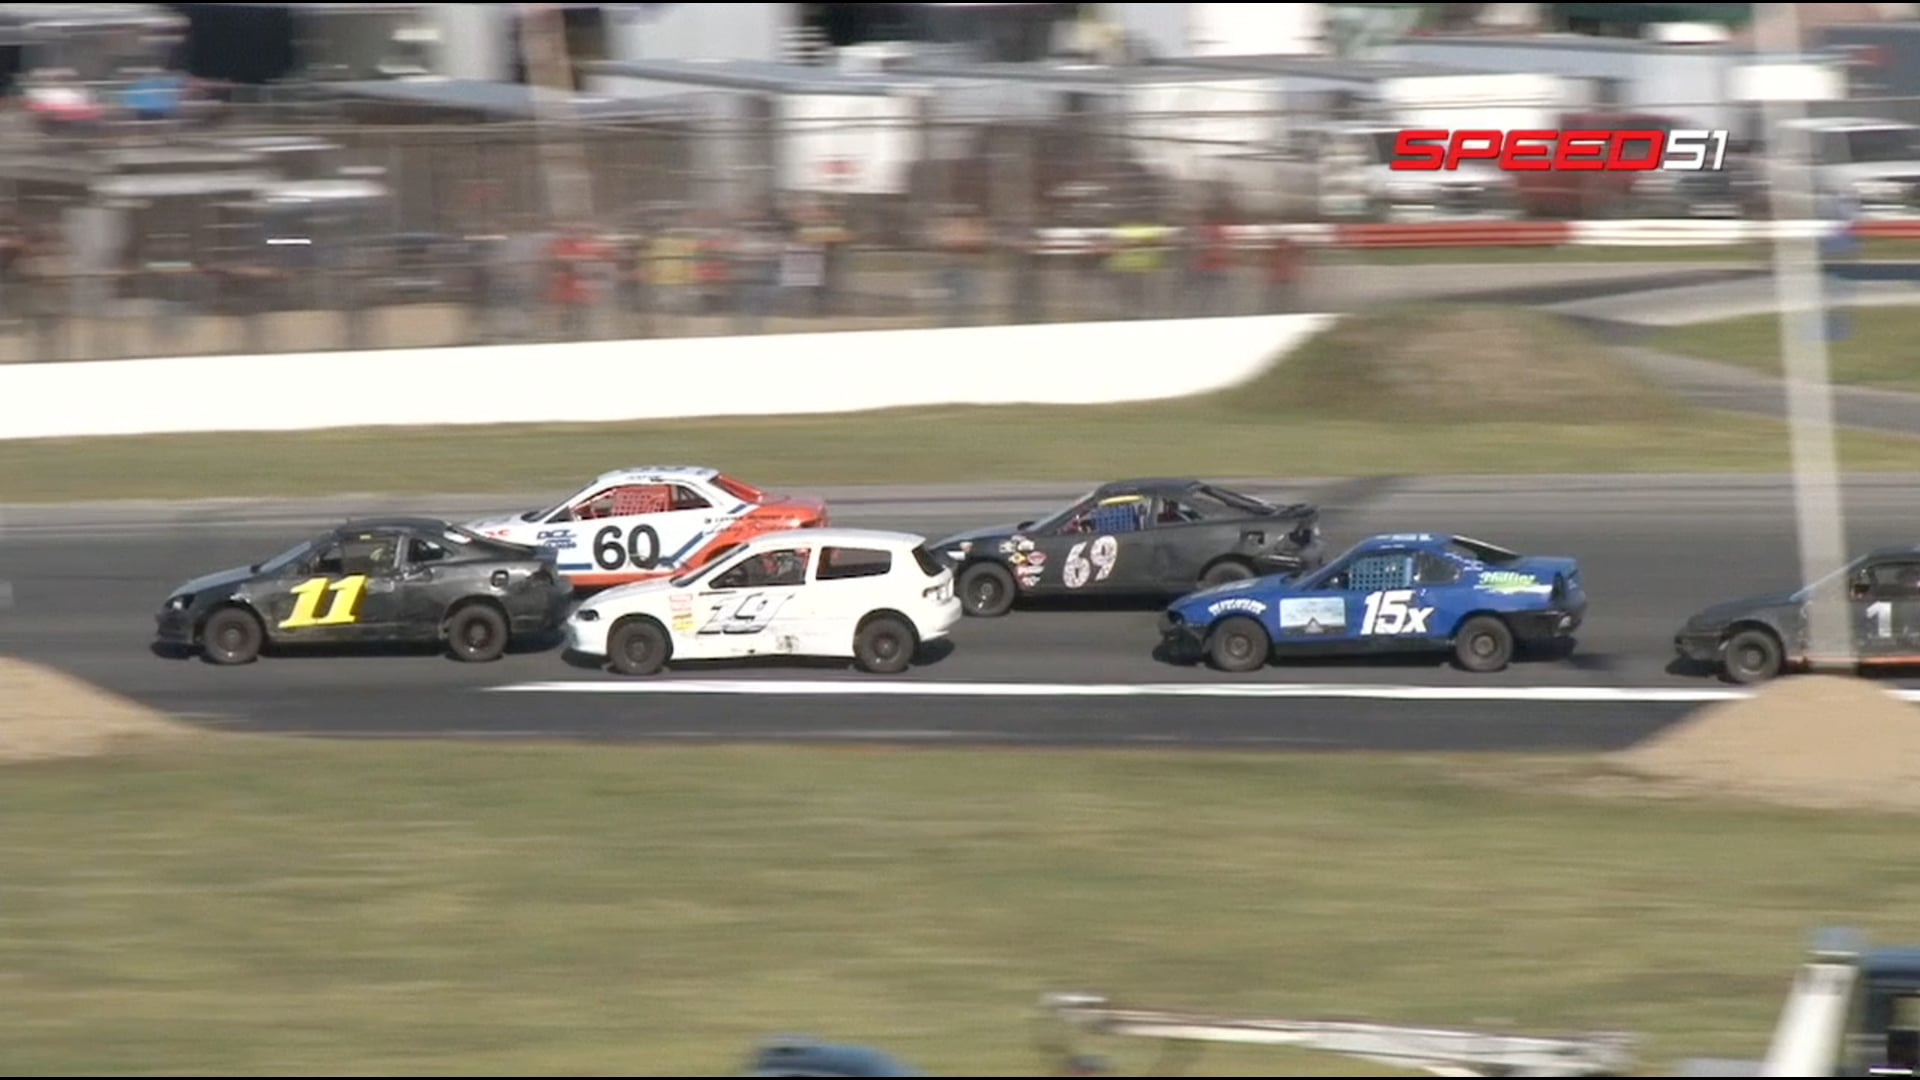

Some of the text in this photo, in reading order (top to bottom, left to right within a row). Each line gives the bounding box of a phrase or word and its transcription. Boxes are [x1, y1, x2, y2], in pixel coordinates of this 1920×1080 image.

[593, 524, 660, 570] 60
[1063, 535, 1118, 588] 69
[278, 575, 367, 629] 11
[1866, 601, 1893, 637] 1
